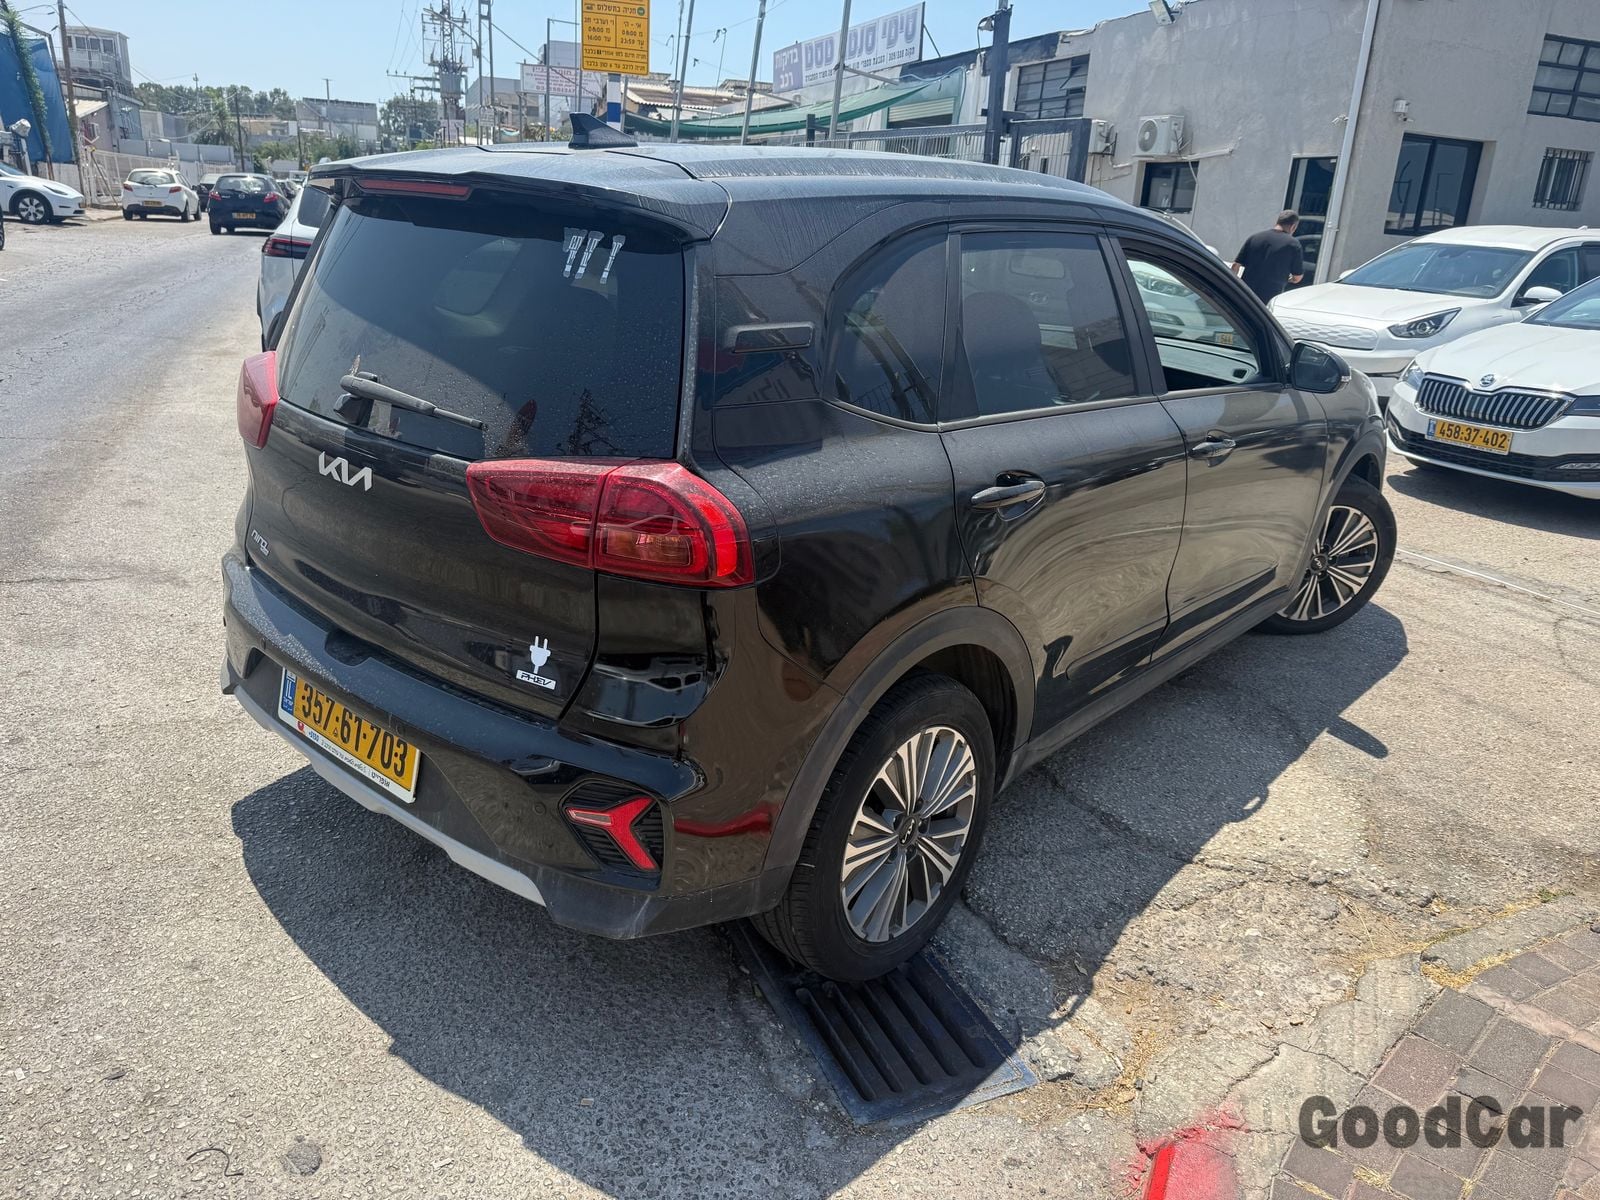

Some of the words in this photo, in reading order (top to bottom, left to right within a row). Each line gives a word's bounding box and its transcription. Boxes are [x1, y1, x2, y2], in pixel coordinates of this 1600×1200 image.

[780, 71, 794, 88] רכב
[318, 450, 373, 492] KIA
[520, 672, 552, 686] PHEV
